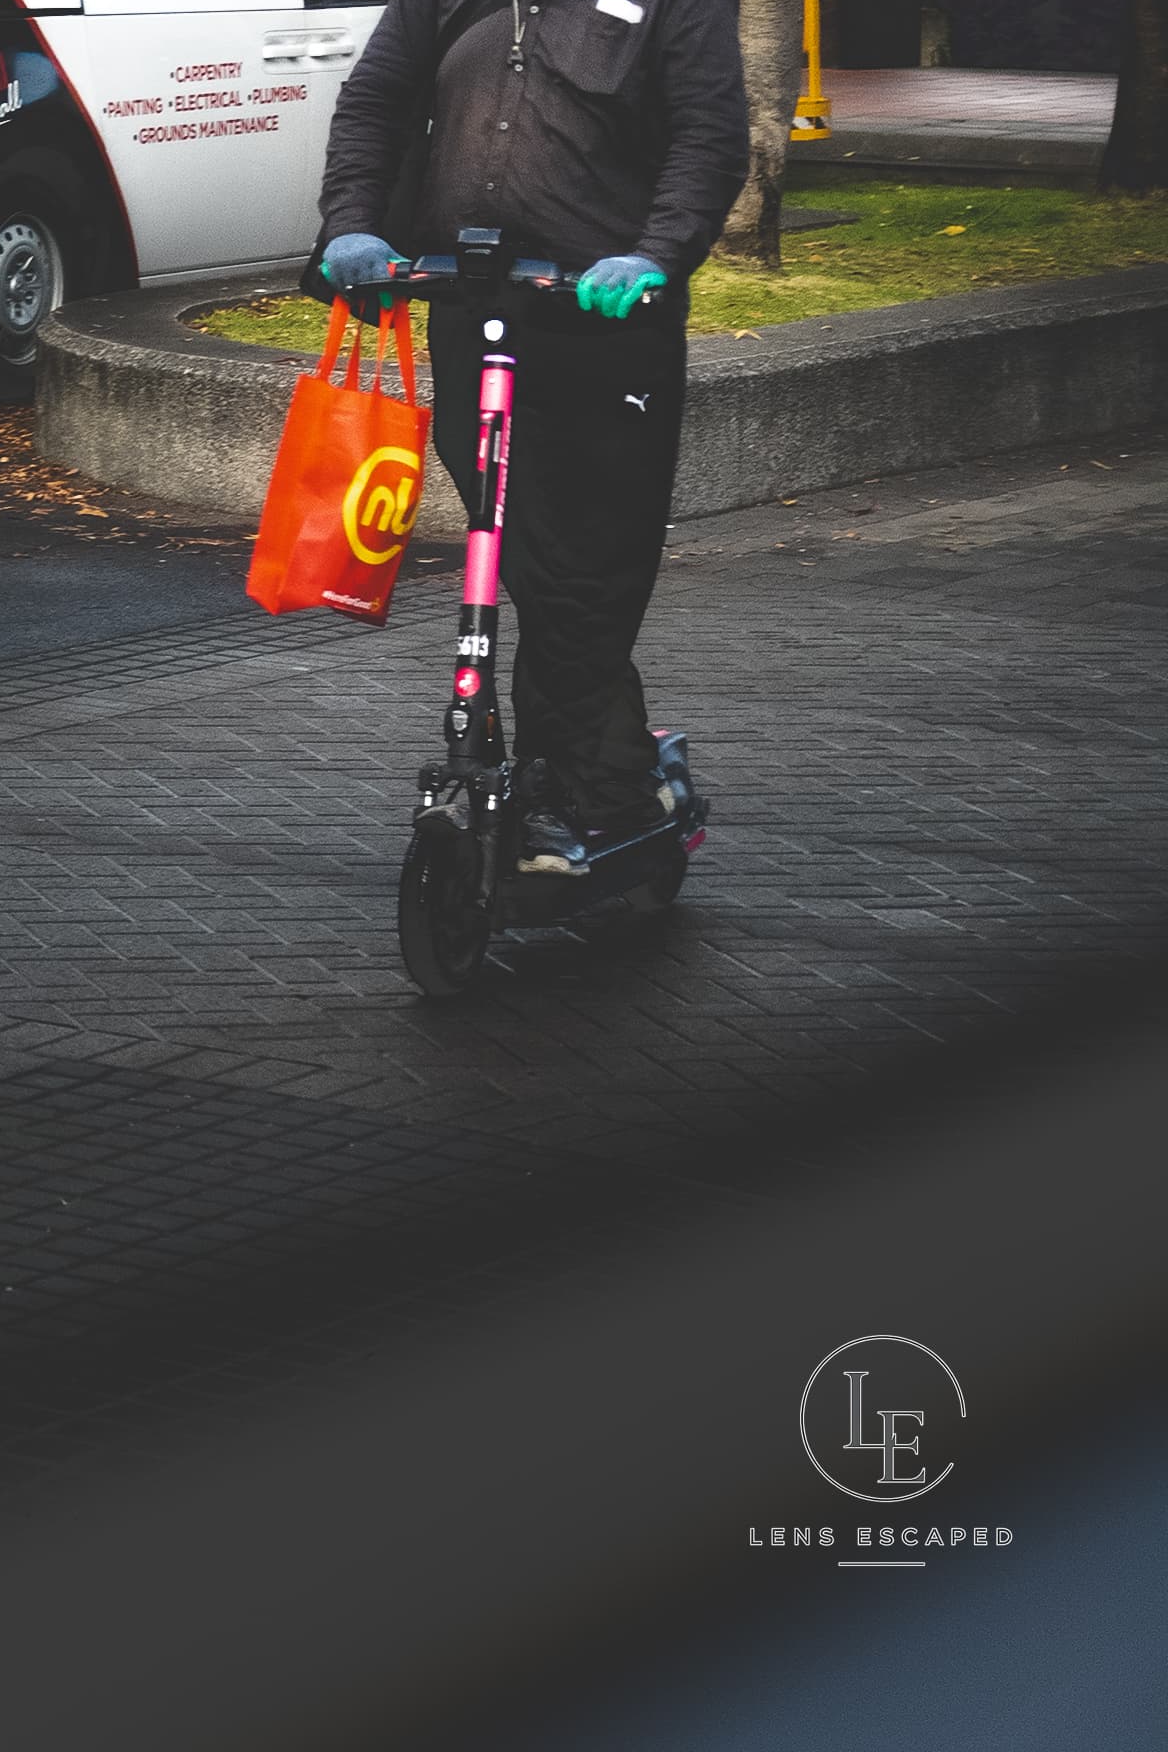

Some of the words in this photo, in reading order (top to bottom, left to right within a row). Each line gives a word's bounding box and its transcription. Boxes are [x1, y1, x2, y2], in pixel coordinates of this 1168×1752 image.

[175, 62, 243, 83] CARPENTRY
[0, 80, 22, 117] all
[108, 98, 164, 117] PAINTING
[175, 91, 243, 112] ELECTRICAL
[138, 123, 196, 144] GROUNDS
[199, 115, 279, 137] MAINTENANCE
